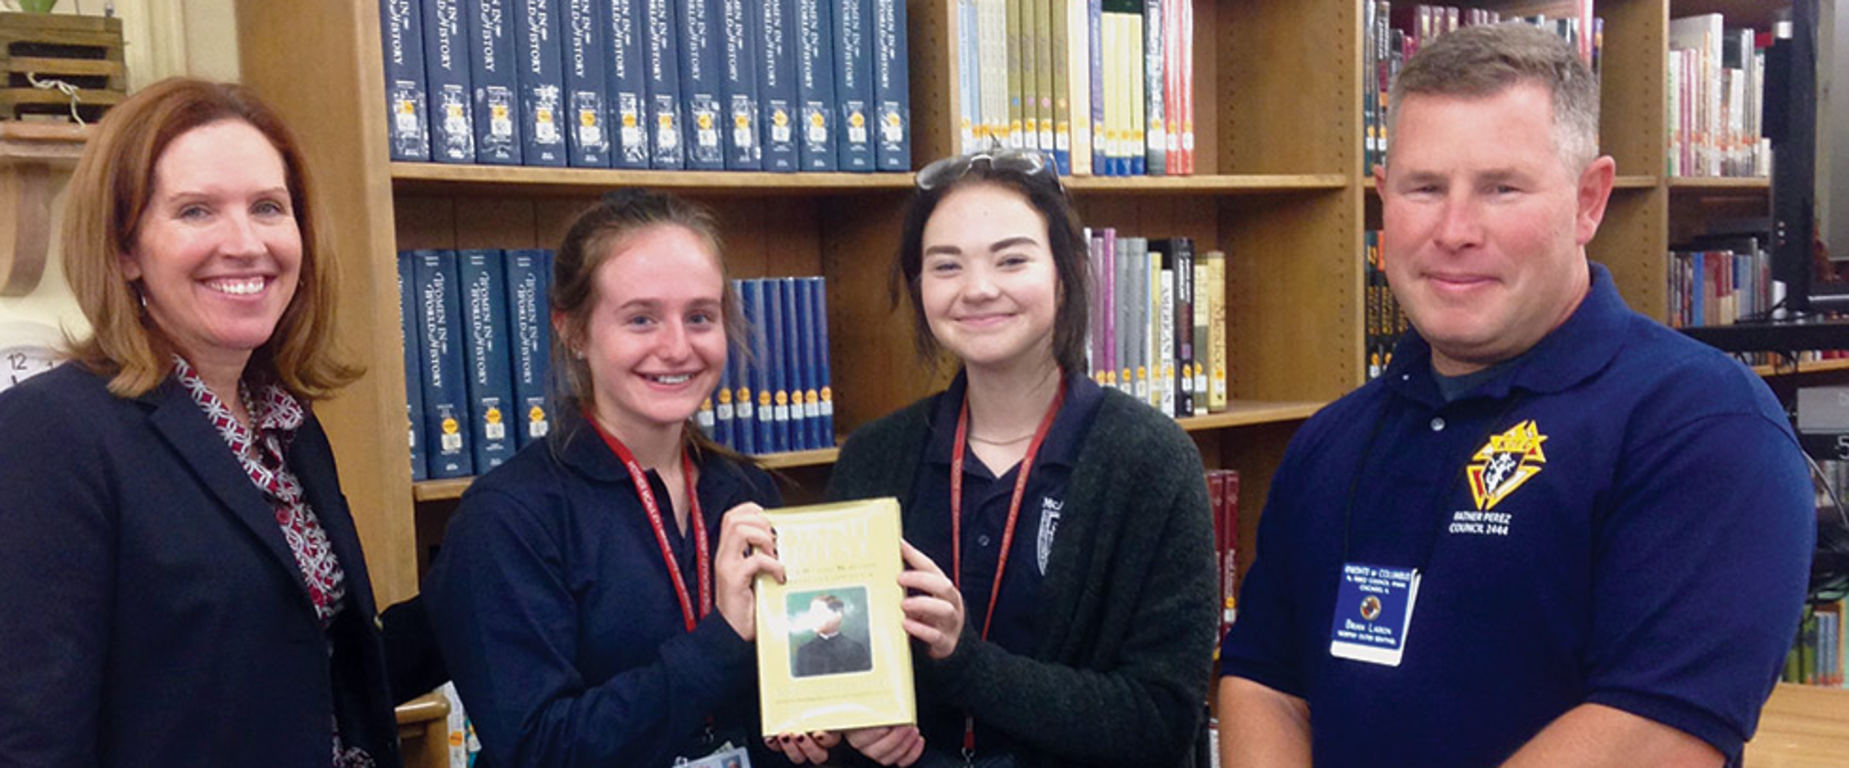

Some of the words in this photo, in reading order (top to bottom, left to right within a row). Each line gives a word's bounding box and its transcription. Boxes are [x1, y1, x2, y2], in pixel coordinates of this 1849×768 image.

[425, 284, 436, 333] WORLD
[434, 271, 446, 324] WOMEN
[471, 282, 482, 331] WORLD
[481, 271, 492, 322] WOMEN
[517, 284, 528, 332] WORLD
[528, 272, 538, 323] WOMEN
[438, 326, 448, 340] IN
[484, 325, 493, 338] IN
[530, 325, 538, 339] IN
[7, 353, 28, 371] 12
[428, 332, 443, 388] HISTORY
[474, 329, 487, 385] HISTORY
[520, 330, 533, 385] HISTORY
[1449, 523, 1484, 534] COUNCIL
[1483, 512, 1512, 525] PEREZ
